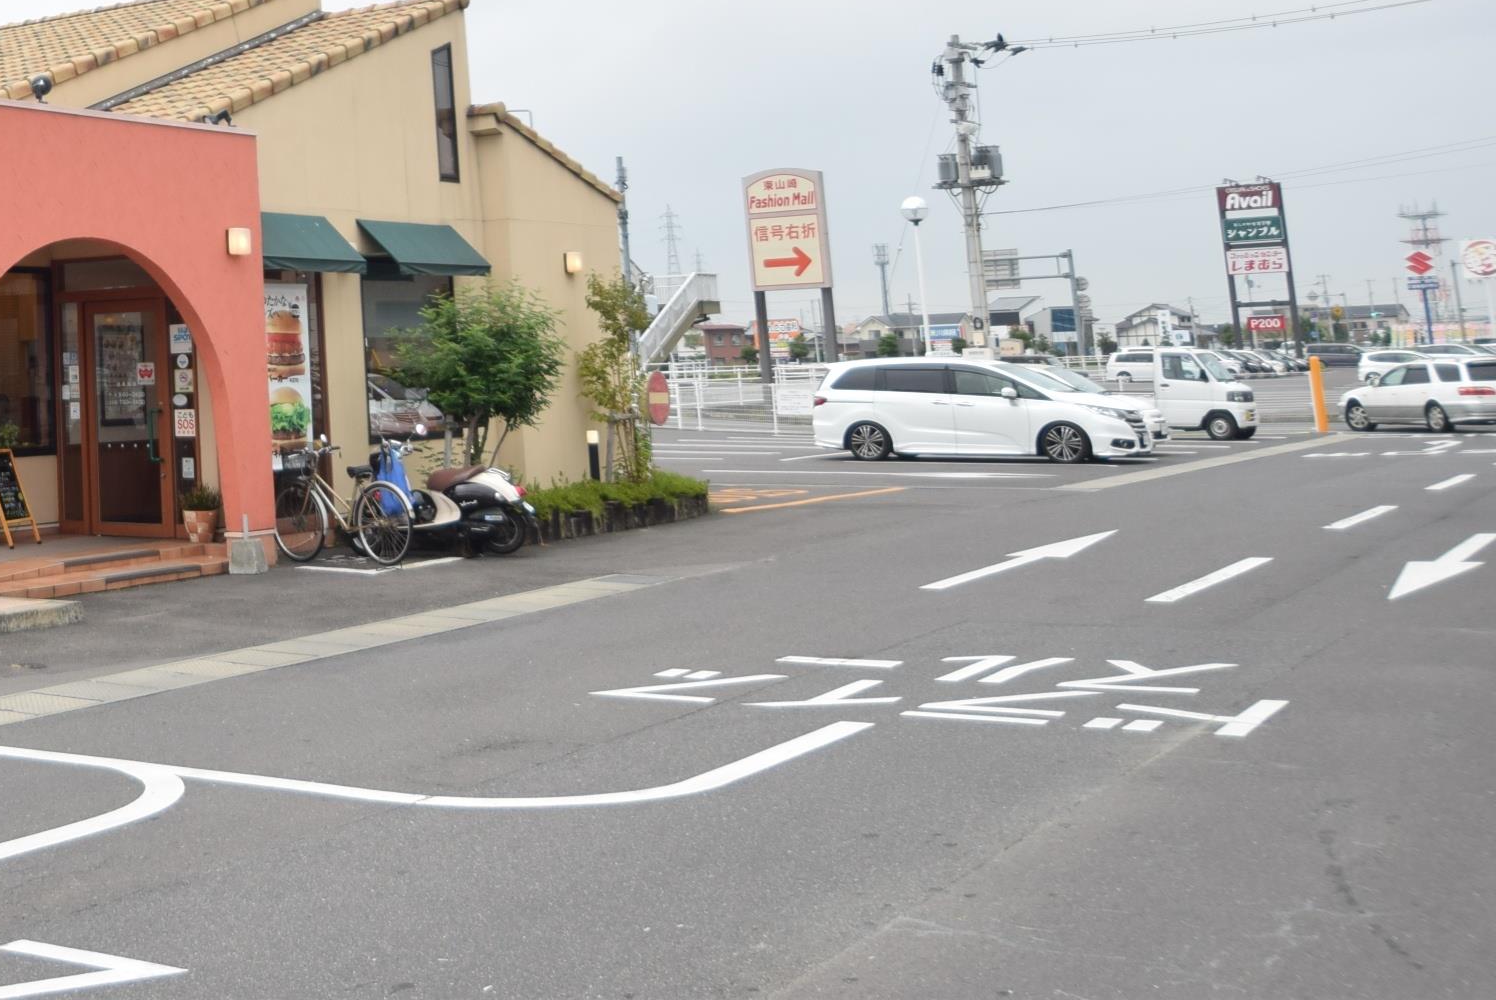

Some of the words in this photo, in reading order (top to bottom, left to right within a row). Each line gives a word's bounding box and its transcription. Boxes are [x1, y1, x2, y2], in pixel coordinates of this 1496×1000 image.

[750, 194, 790, 208] Fashion
[793, 191, 814, 205] Mall
[1225, 190, 1273, 209] Avail
[755, 223, 816, 241] 信号右折
[1231, 259, 1283, 272] しまむら
[1250, 318, 1281, 329] P200
[177, 419, 195, 429] SOS
